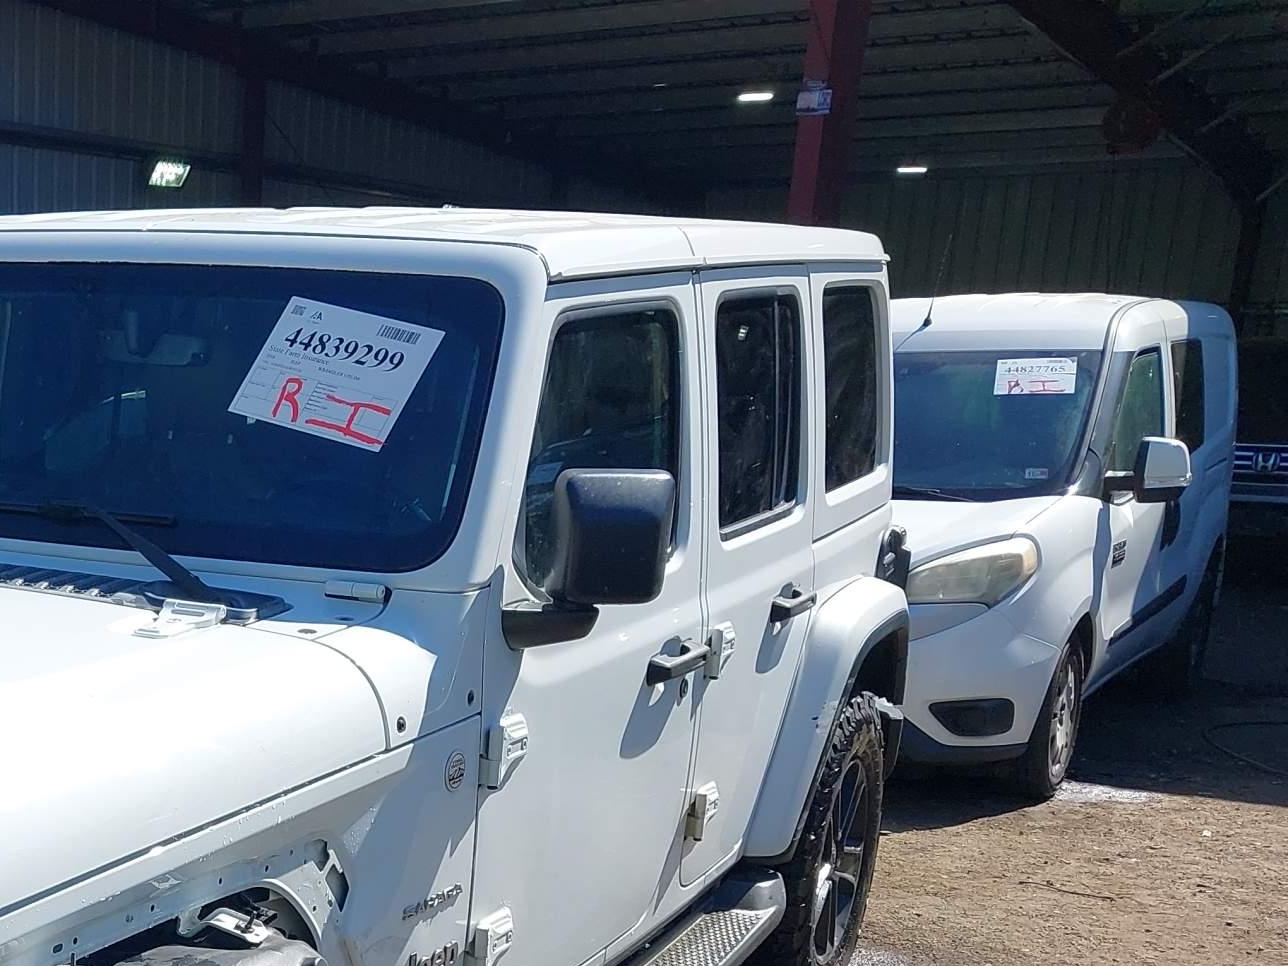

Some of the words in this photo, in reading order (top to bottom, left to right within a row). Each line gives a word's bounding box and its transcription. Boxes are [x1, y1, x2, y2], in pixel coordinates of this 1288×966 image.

[284, 327, 405, 372] 44839299
[1004, 365, 1066, 374] 44827765
[272, 377, 303, 423] R
[402, 882, 463, 920] SAHARA
